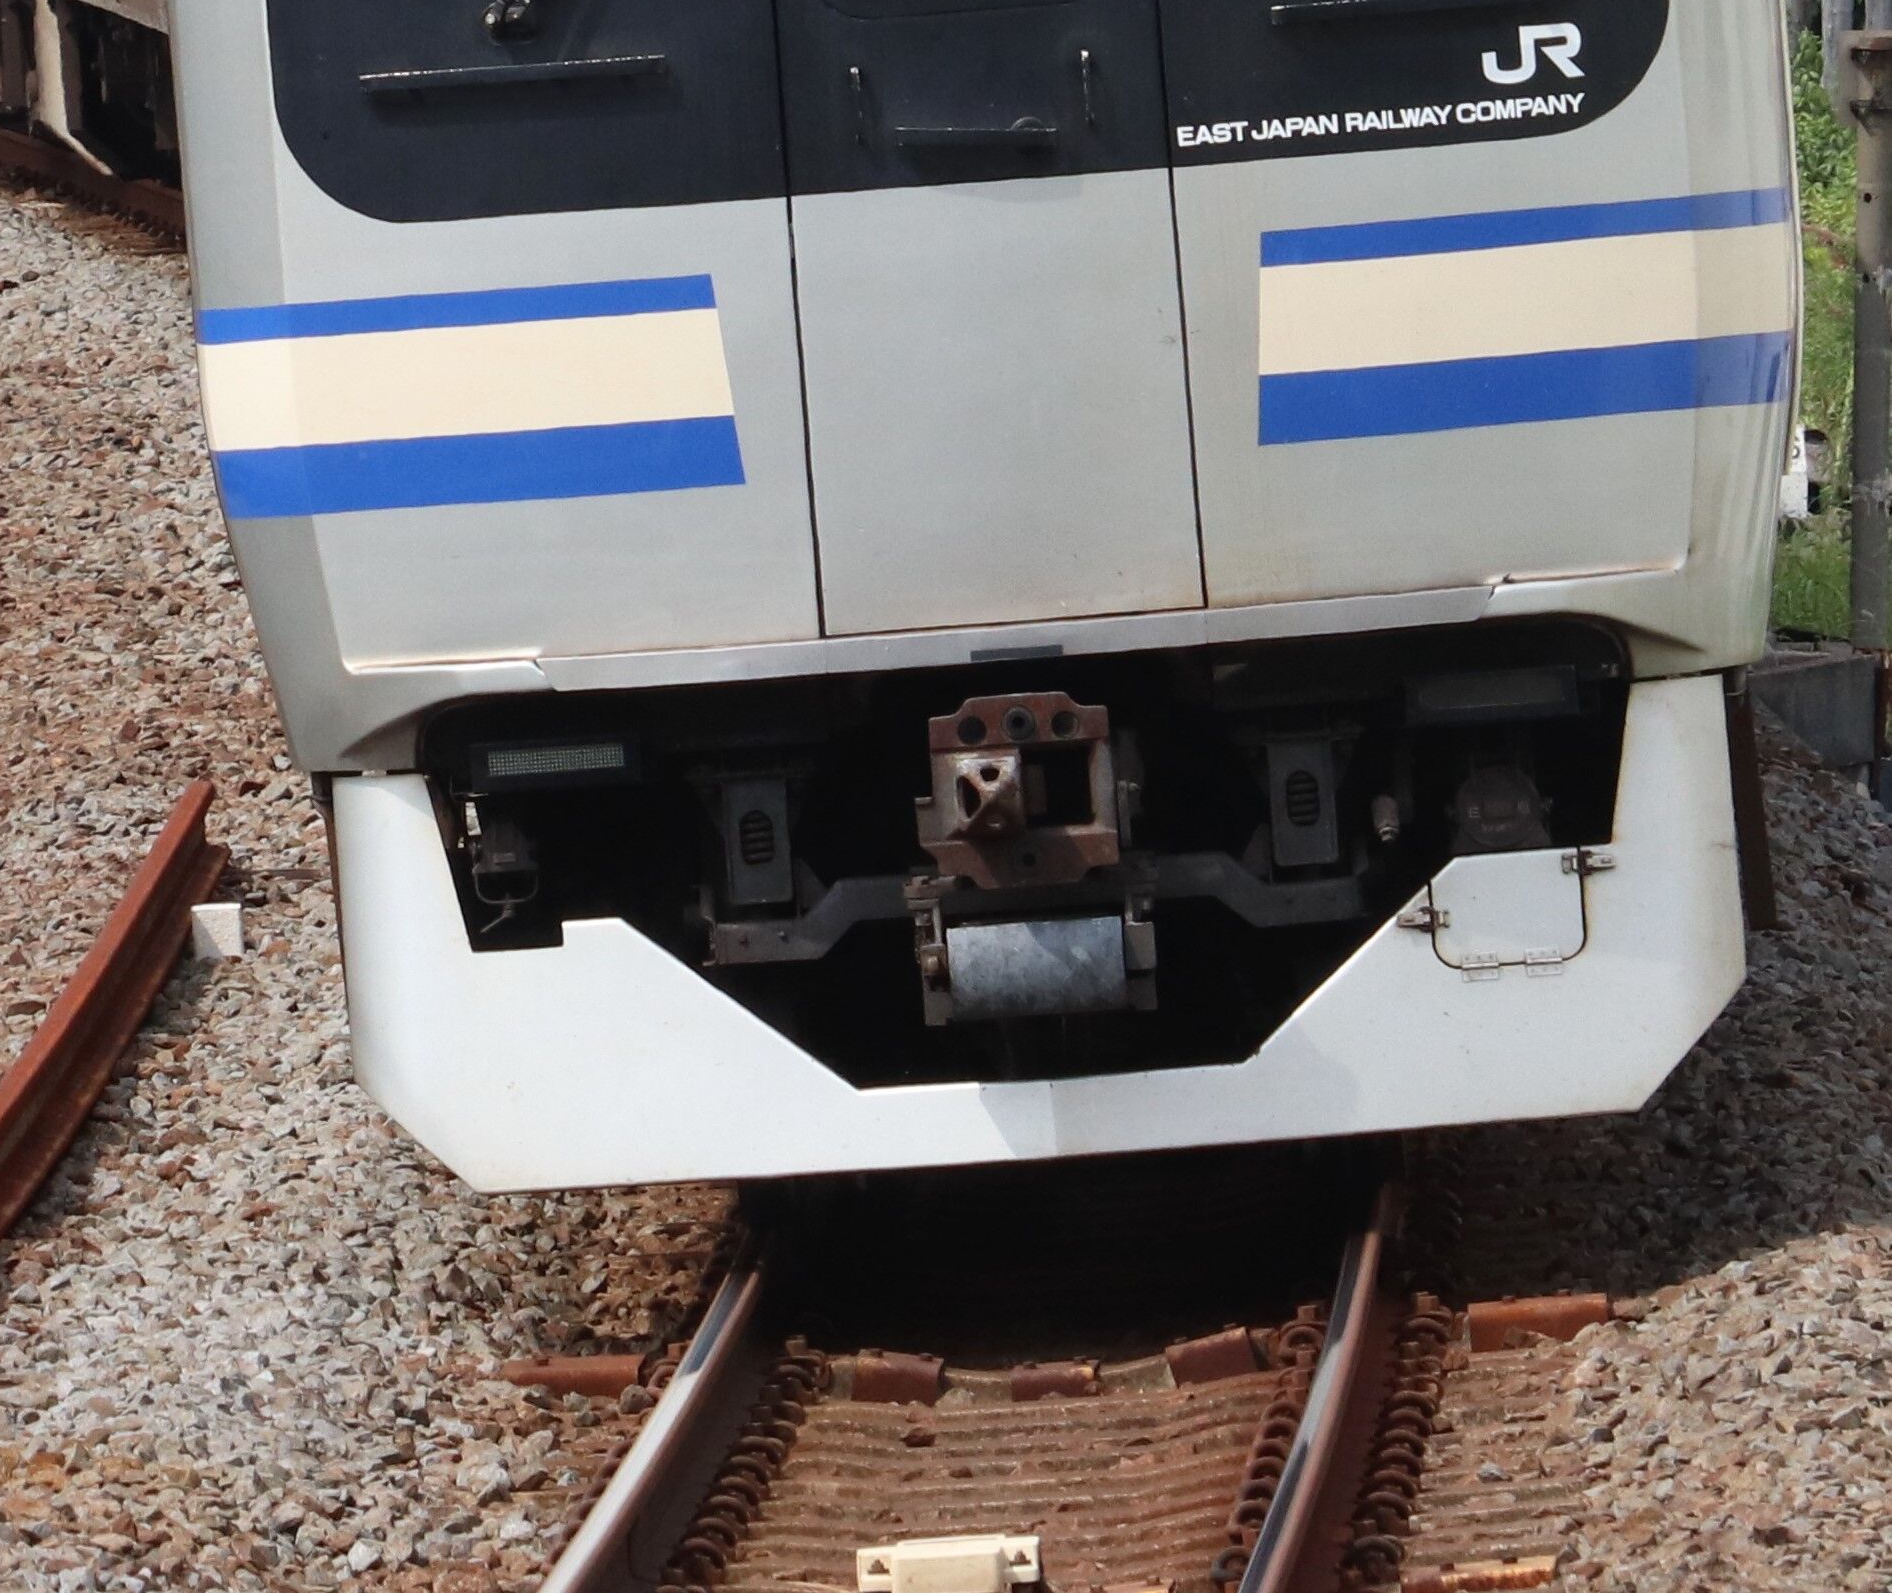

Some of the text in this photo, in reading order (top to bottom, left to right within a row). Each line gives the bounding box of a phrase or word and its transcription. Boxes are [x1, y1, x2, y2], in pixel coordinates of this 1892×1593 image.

[1481, 22, 1586, 85] JR
[1176, 93, 1585, 148] EAST JAPAN RAILWAY COMPANY
